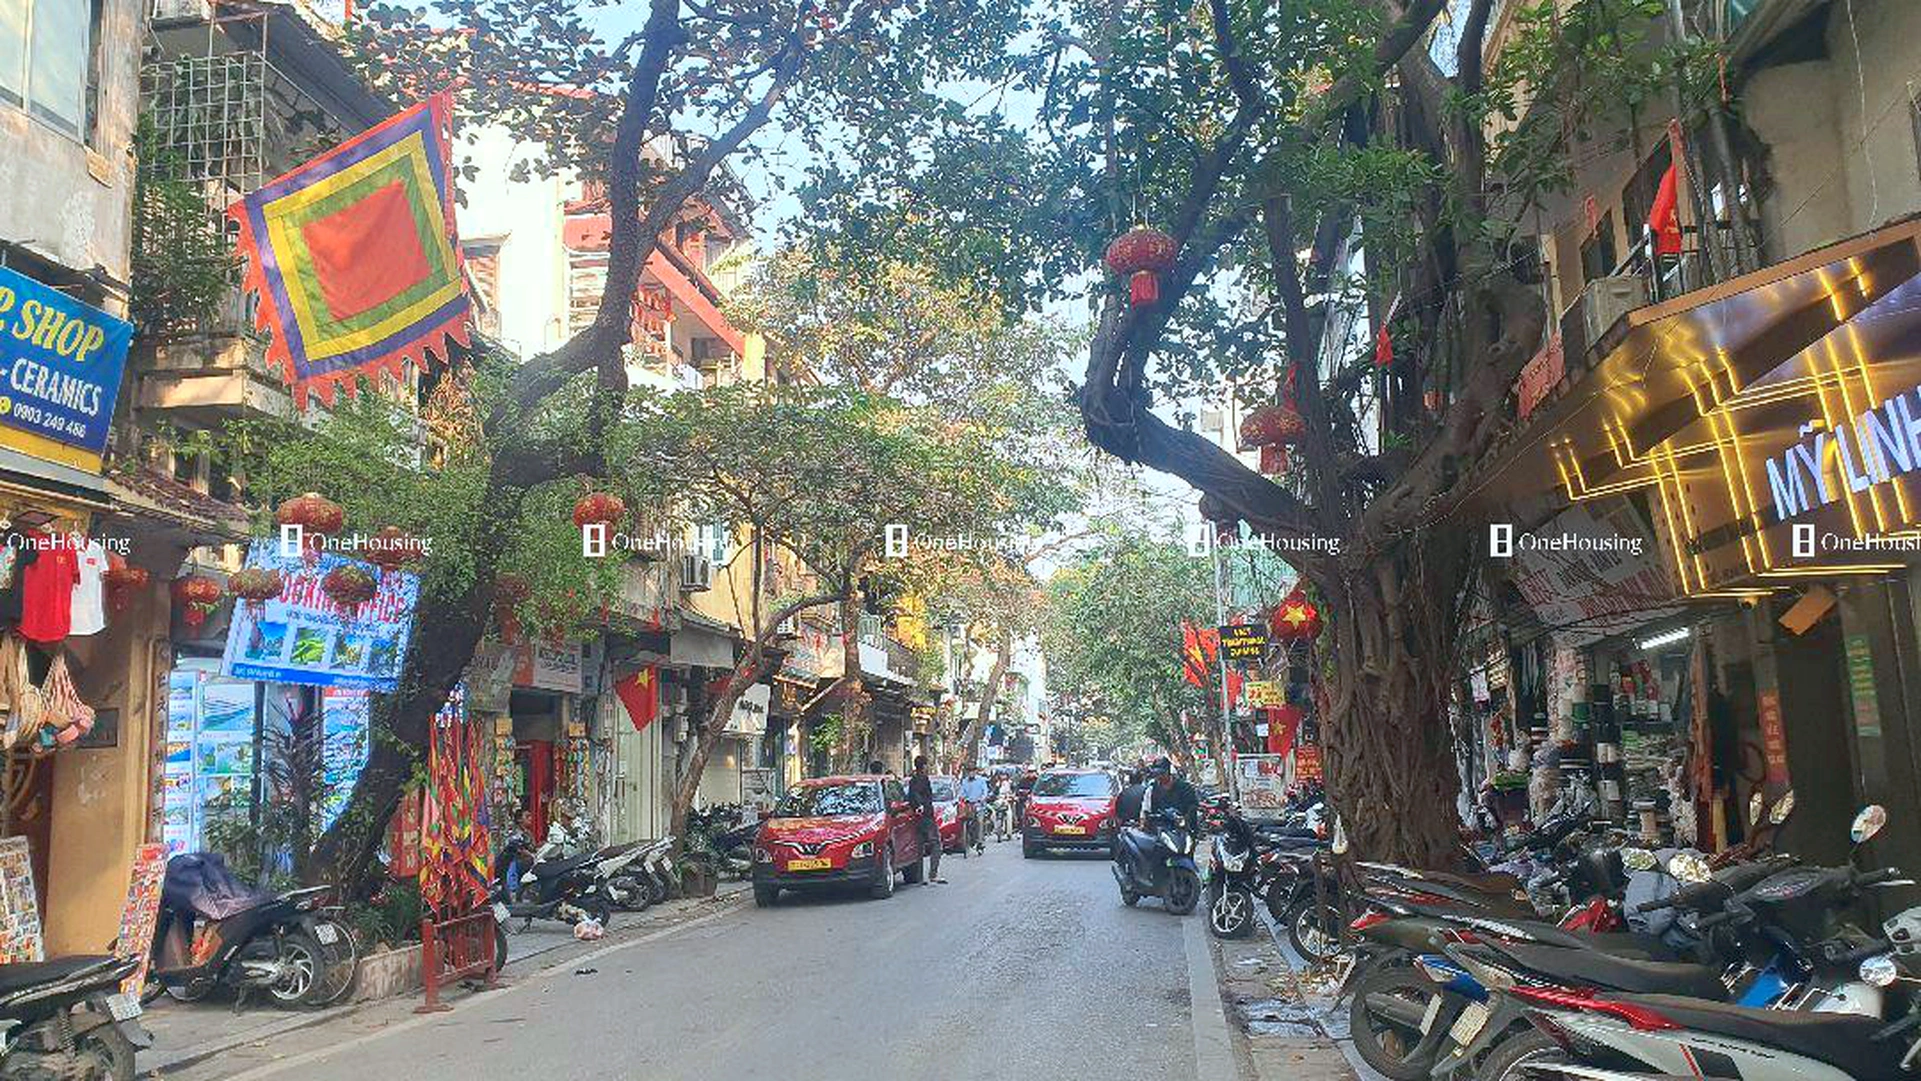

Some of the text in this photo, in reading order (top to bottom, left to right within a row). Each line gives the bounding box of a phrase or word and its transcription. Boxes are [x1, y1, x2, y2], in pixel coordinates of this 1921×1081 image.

[12, 299, 105, 361] SHOP
[10, 357, 103, 417] CERAMICS
[1834, 386, 1921, 493] LINH
